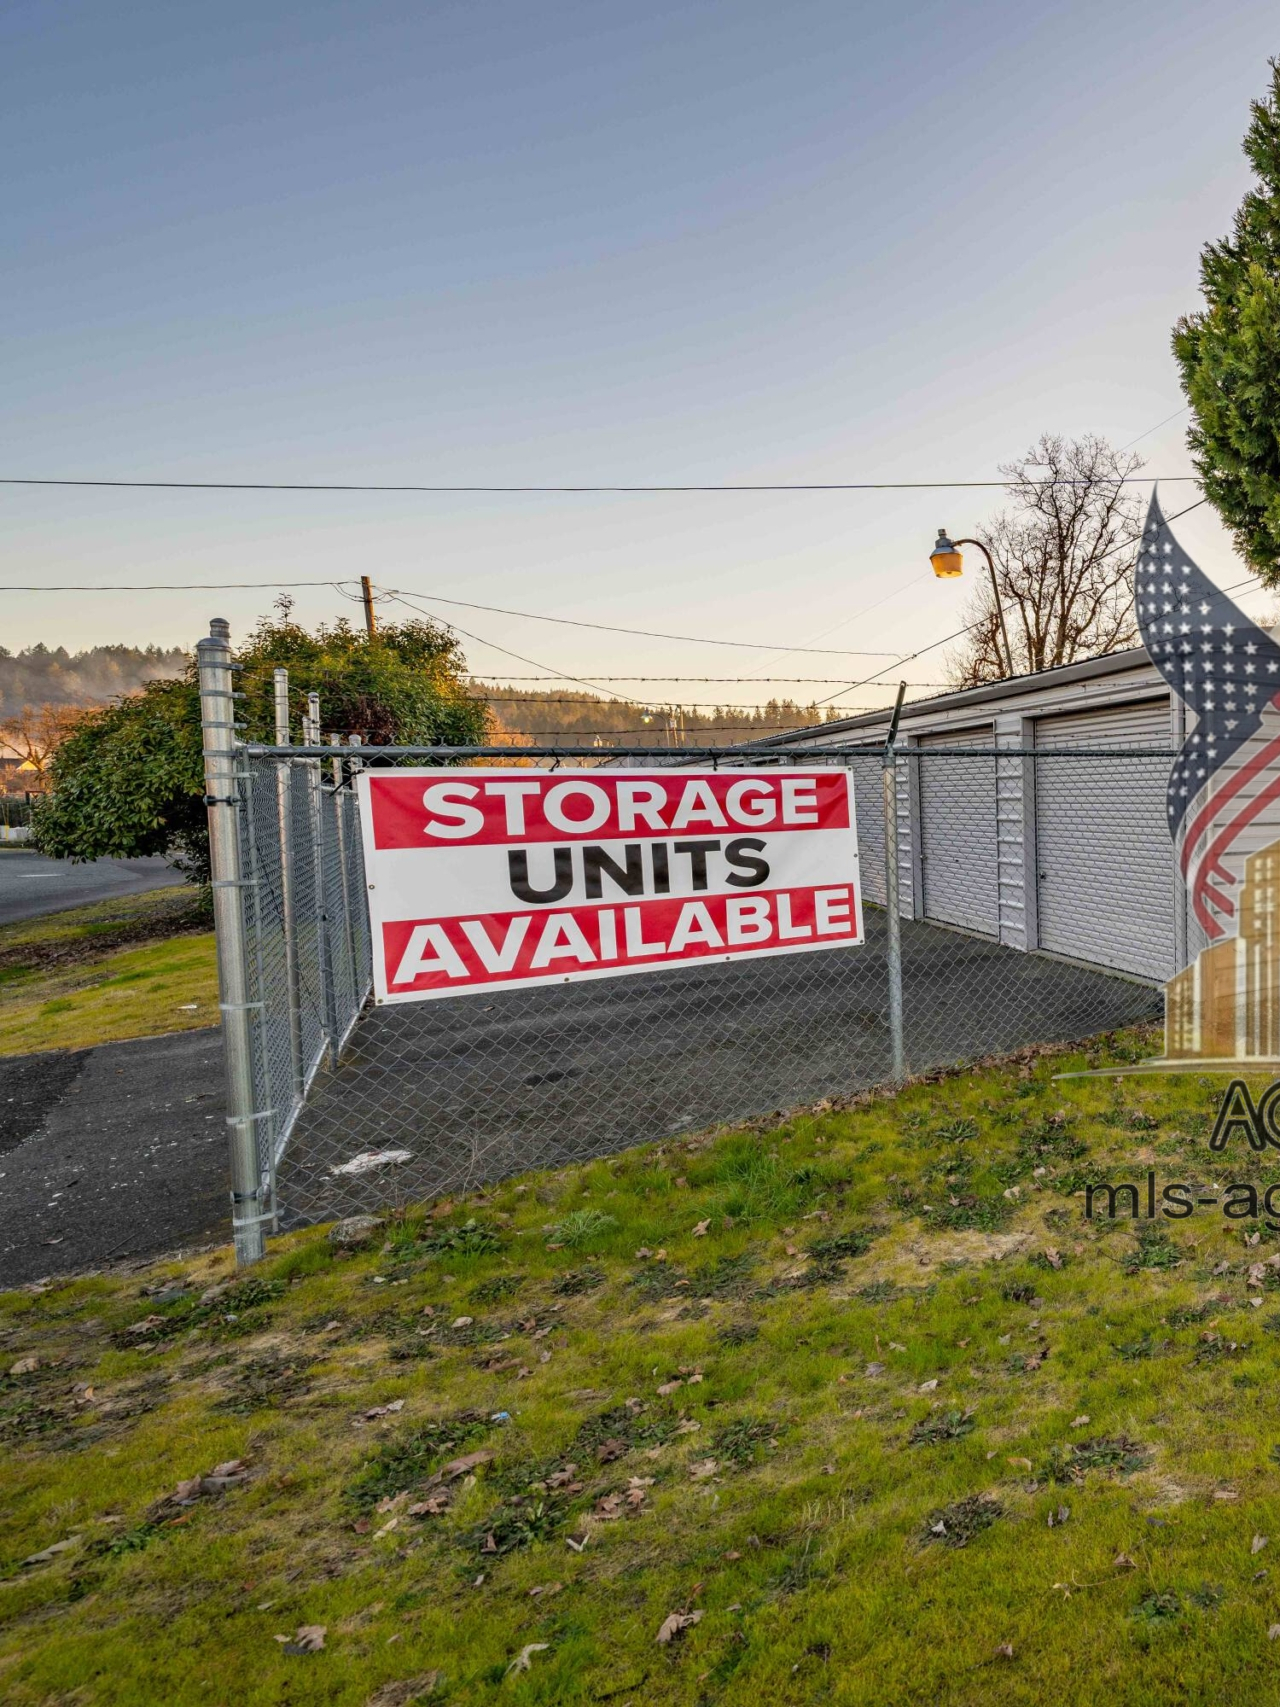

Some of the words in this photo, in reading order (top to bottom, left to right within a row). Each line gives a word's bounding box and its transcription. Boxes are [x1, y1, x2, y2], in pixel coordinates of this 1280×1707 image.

[422, 778, 819, 840] STORAGE
[507, 837, 771, 905] UNITS
[392, 888, 852, 985] AVAILABLE
